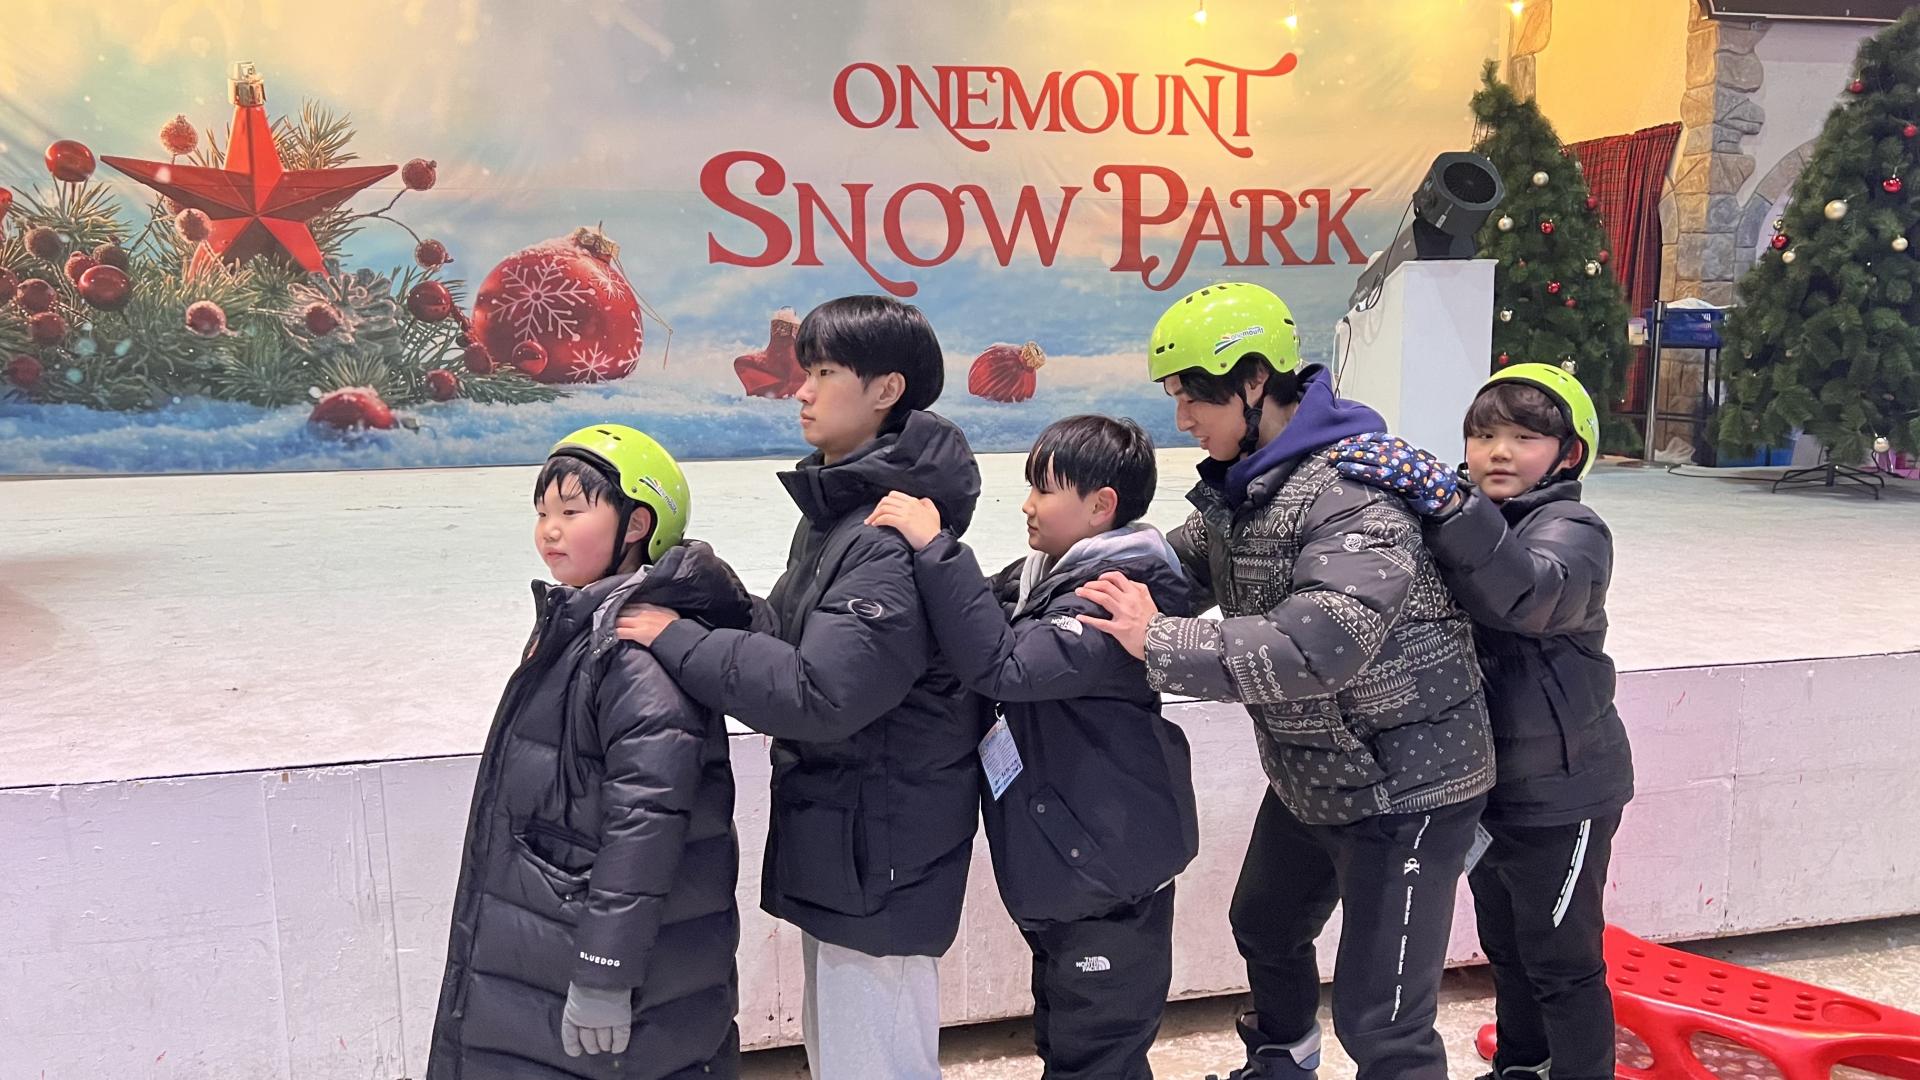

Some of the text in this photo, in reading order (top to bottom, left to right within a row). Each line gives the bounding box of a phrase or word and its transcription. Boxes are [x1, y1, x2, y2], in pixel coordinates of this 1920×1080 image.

[833, 52, 1297, 158] ONEMOUNT
[700, 150, 1372, 297] SNOW PARK
[580, 951, 620, 967] BLUEDOG
